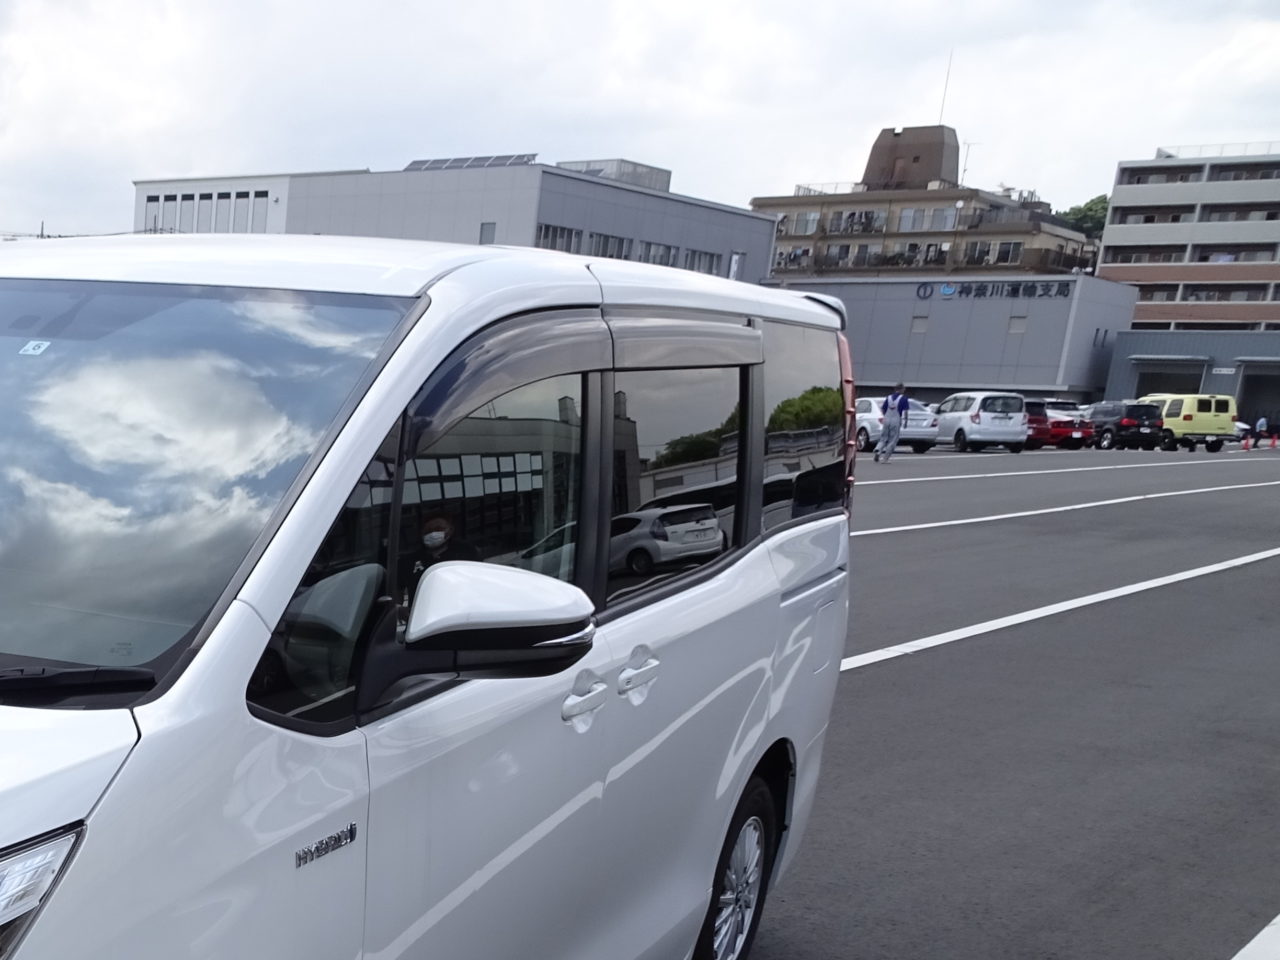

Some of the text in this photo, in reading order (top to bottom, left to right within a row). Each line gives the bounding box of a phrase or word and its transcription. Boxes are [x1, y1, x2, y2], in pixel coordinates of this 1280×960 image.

[958, 282, 1070, 298] 神奈川運輸支局
